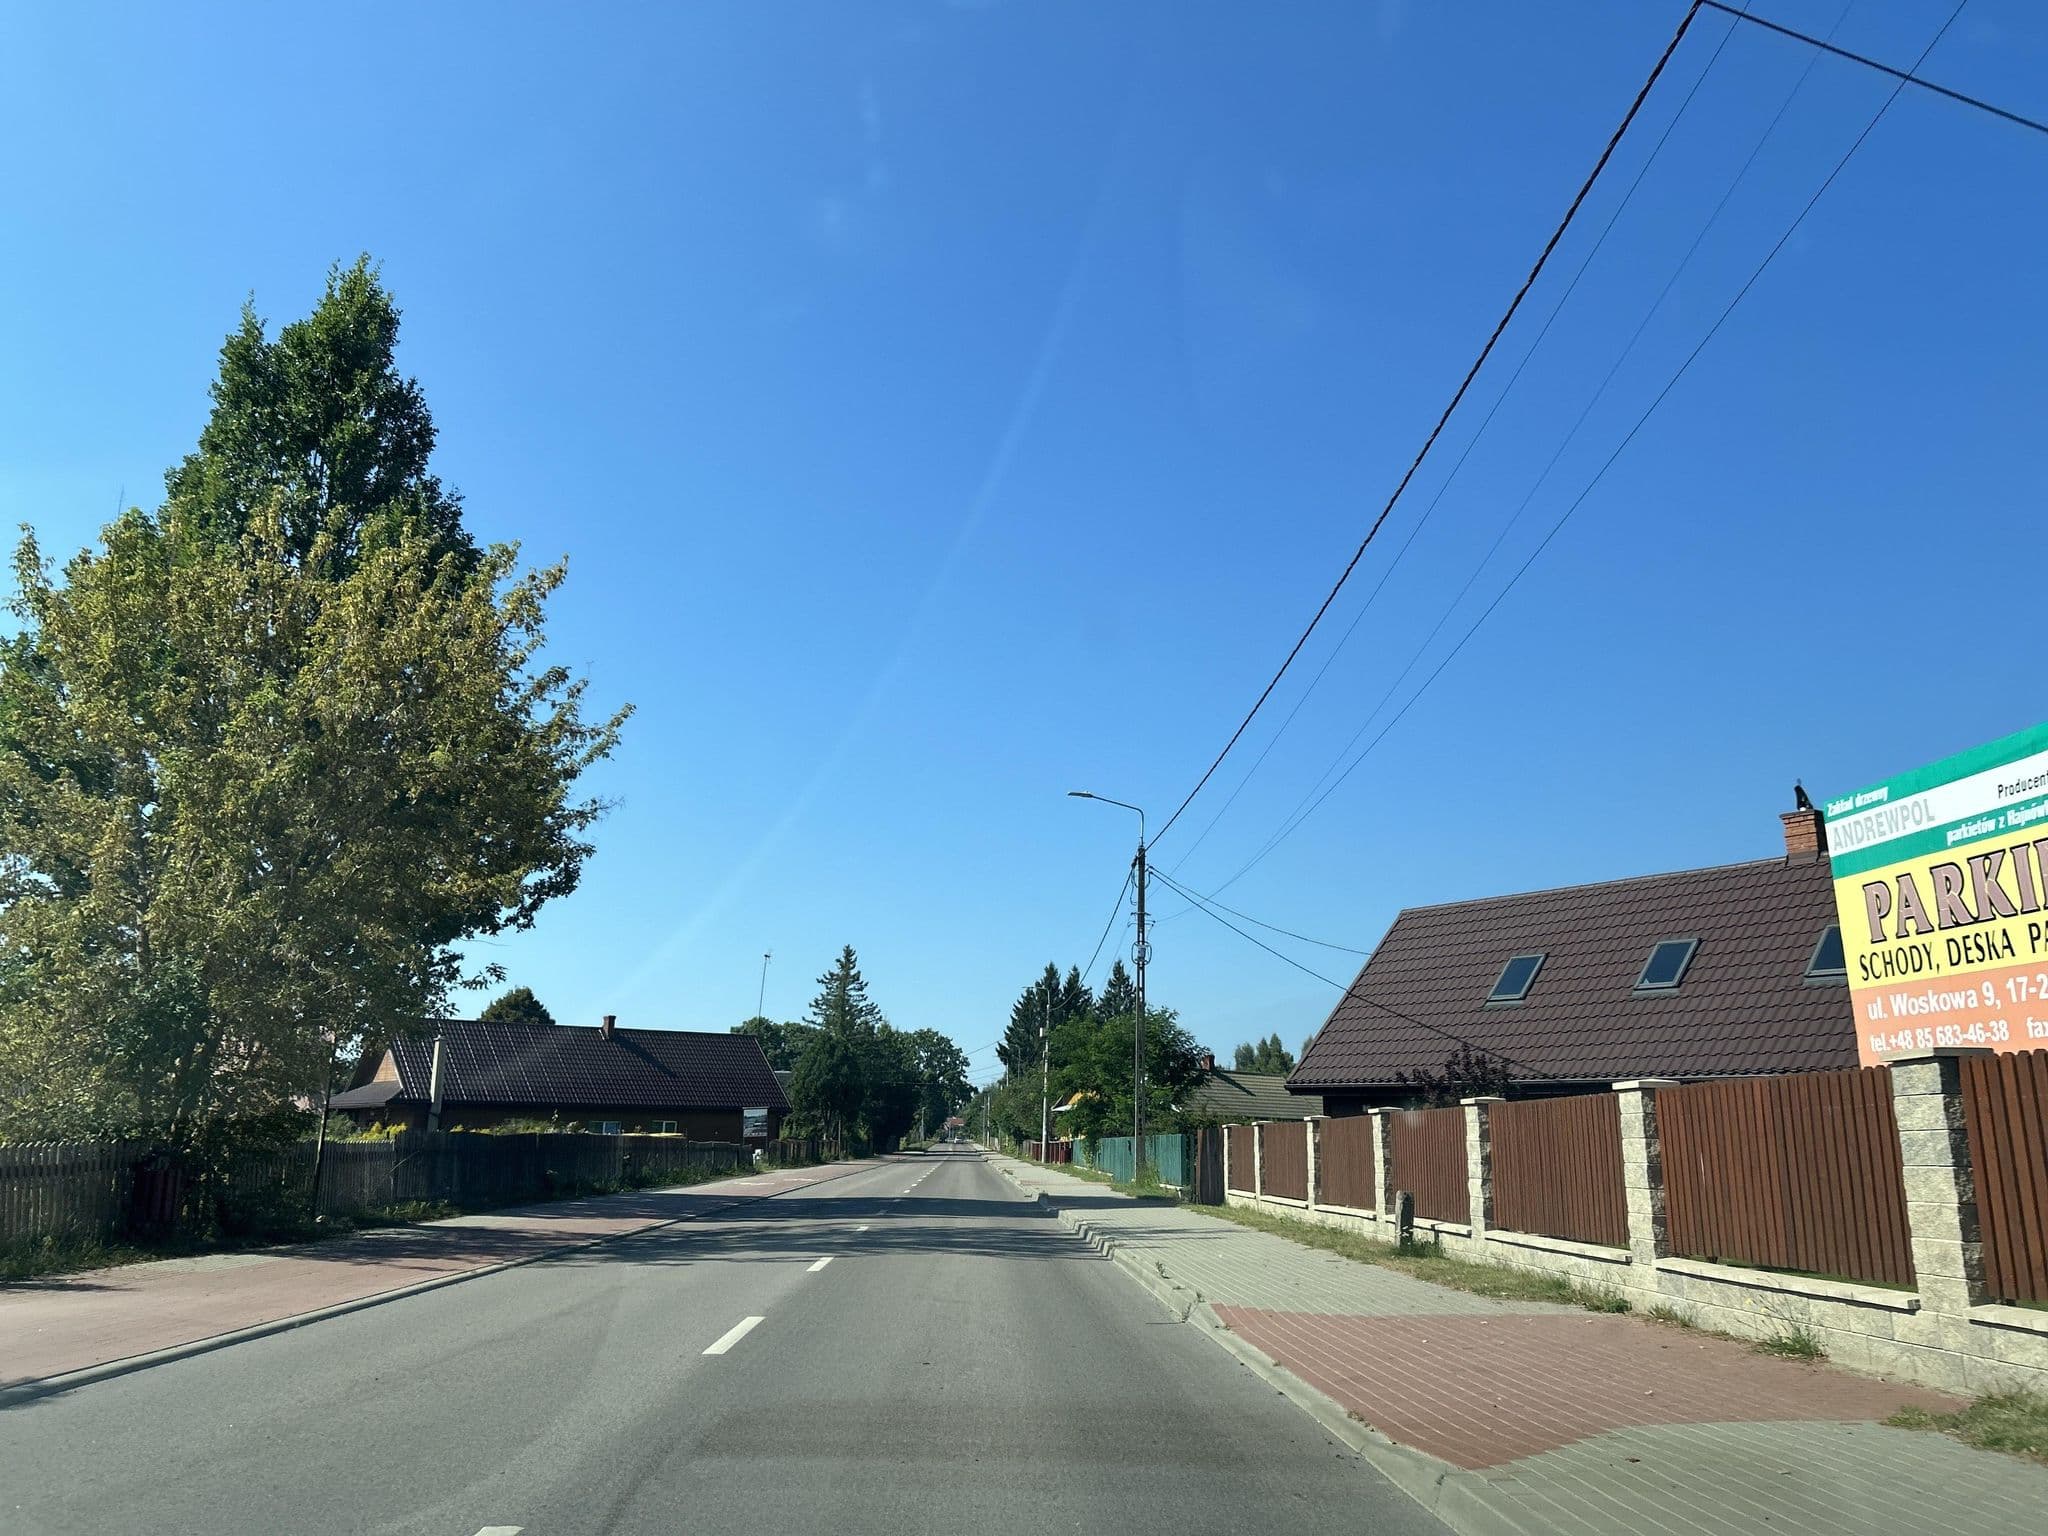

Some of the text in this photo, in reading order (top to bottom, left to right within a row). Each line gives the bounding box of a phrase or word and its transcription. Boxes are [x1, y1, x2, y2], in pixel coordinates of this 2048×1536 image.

[1832, 798, 1936, 851] ANDREWPOL
[1998, 815, 2006, 829] z
[1859, 940, 1940, 981] SCHODY,
[1946, 928, 2016, 967] DESKA
[1867, 973, 2048, 1021] ul. Woskowa 9, 17-2
[1916, 1026, 1934, 1048] 85
[1936, 1019, 2010, 1046] 683-46-38
